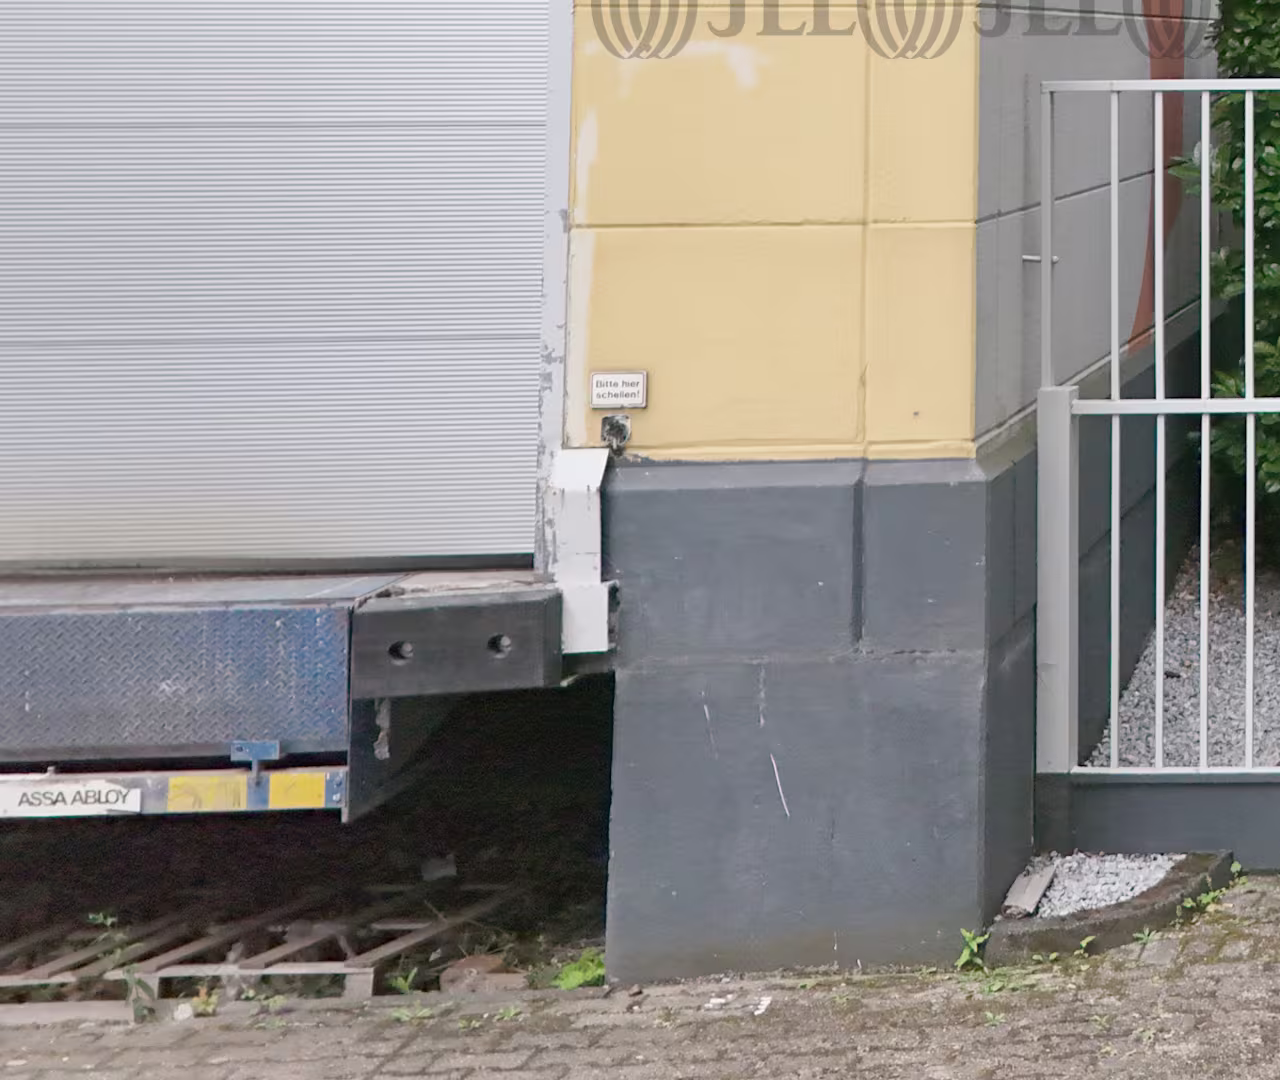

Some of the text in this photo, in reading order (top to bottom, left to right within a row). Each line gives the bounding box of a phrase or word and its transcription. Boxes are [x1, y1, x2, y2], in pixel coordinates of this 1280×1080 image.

[595, 380, 640, 389] Bitte hier
[18, 789, 130, 807] ASSA ABLOY
